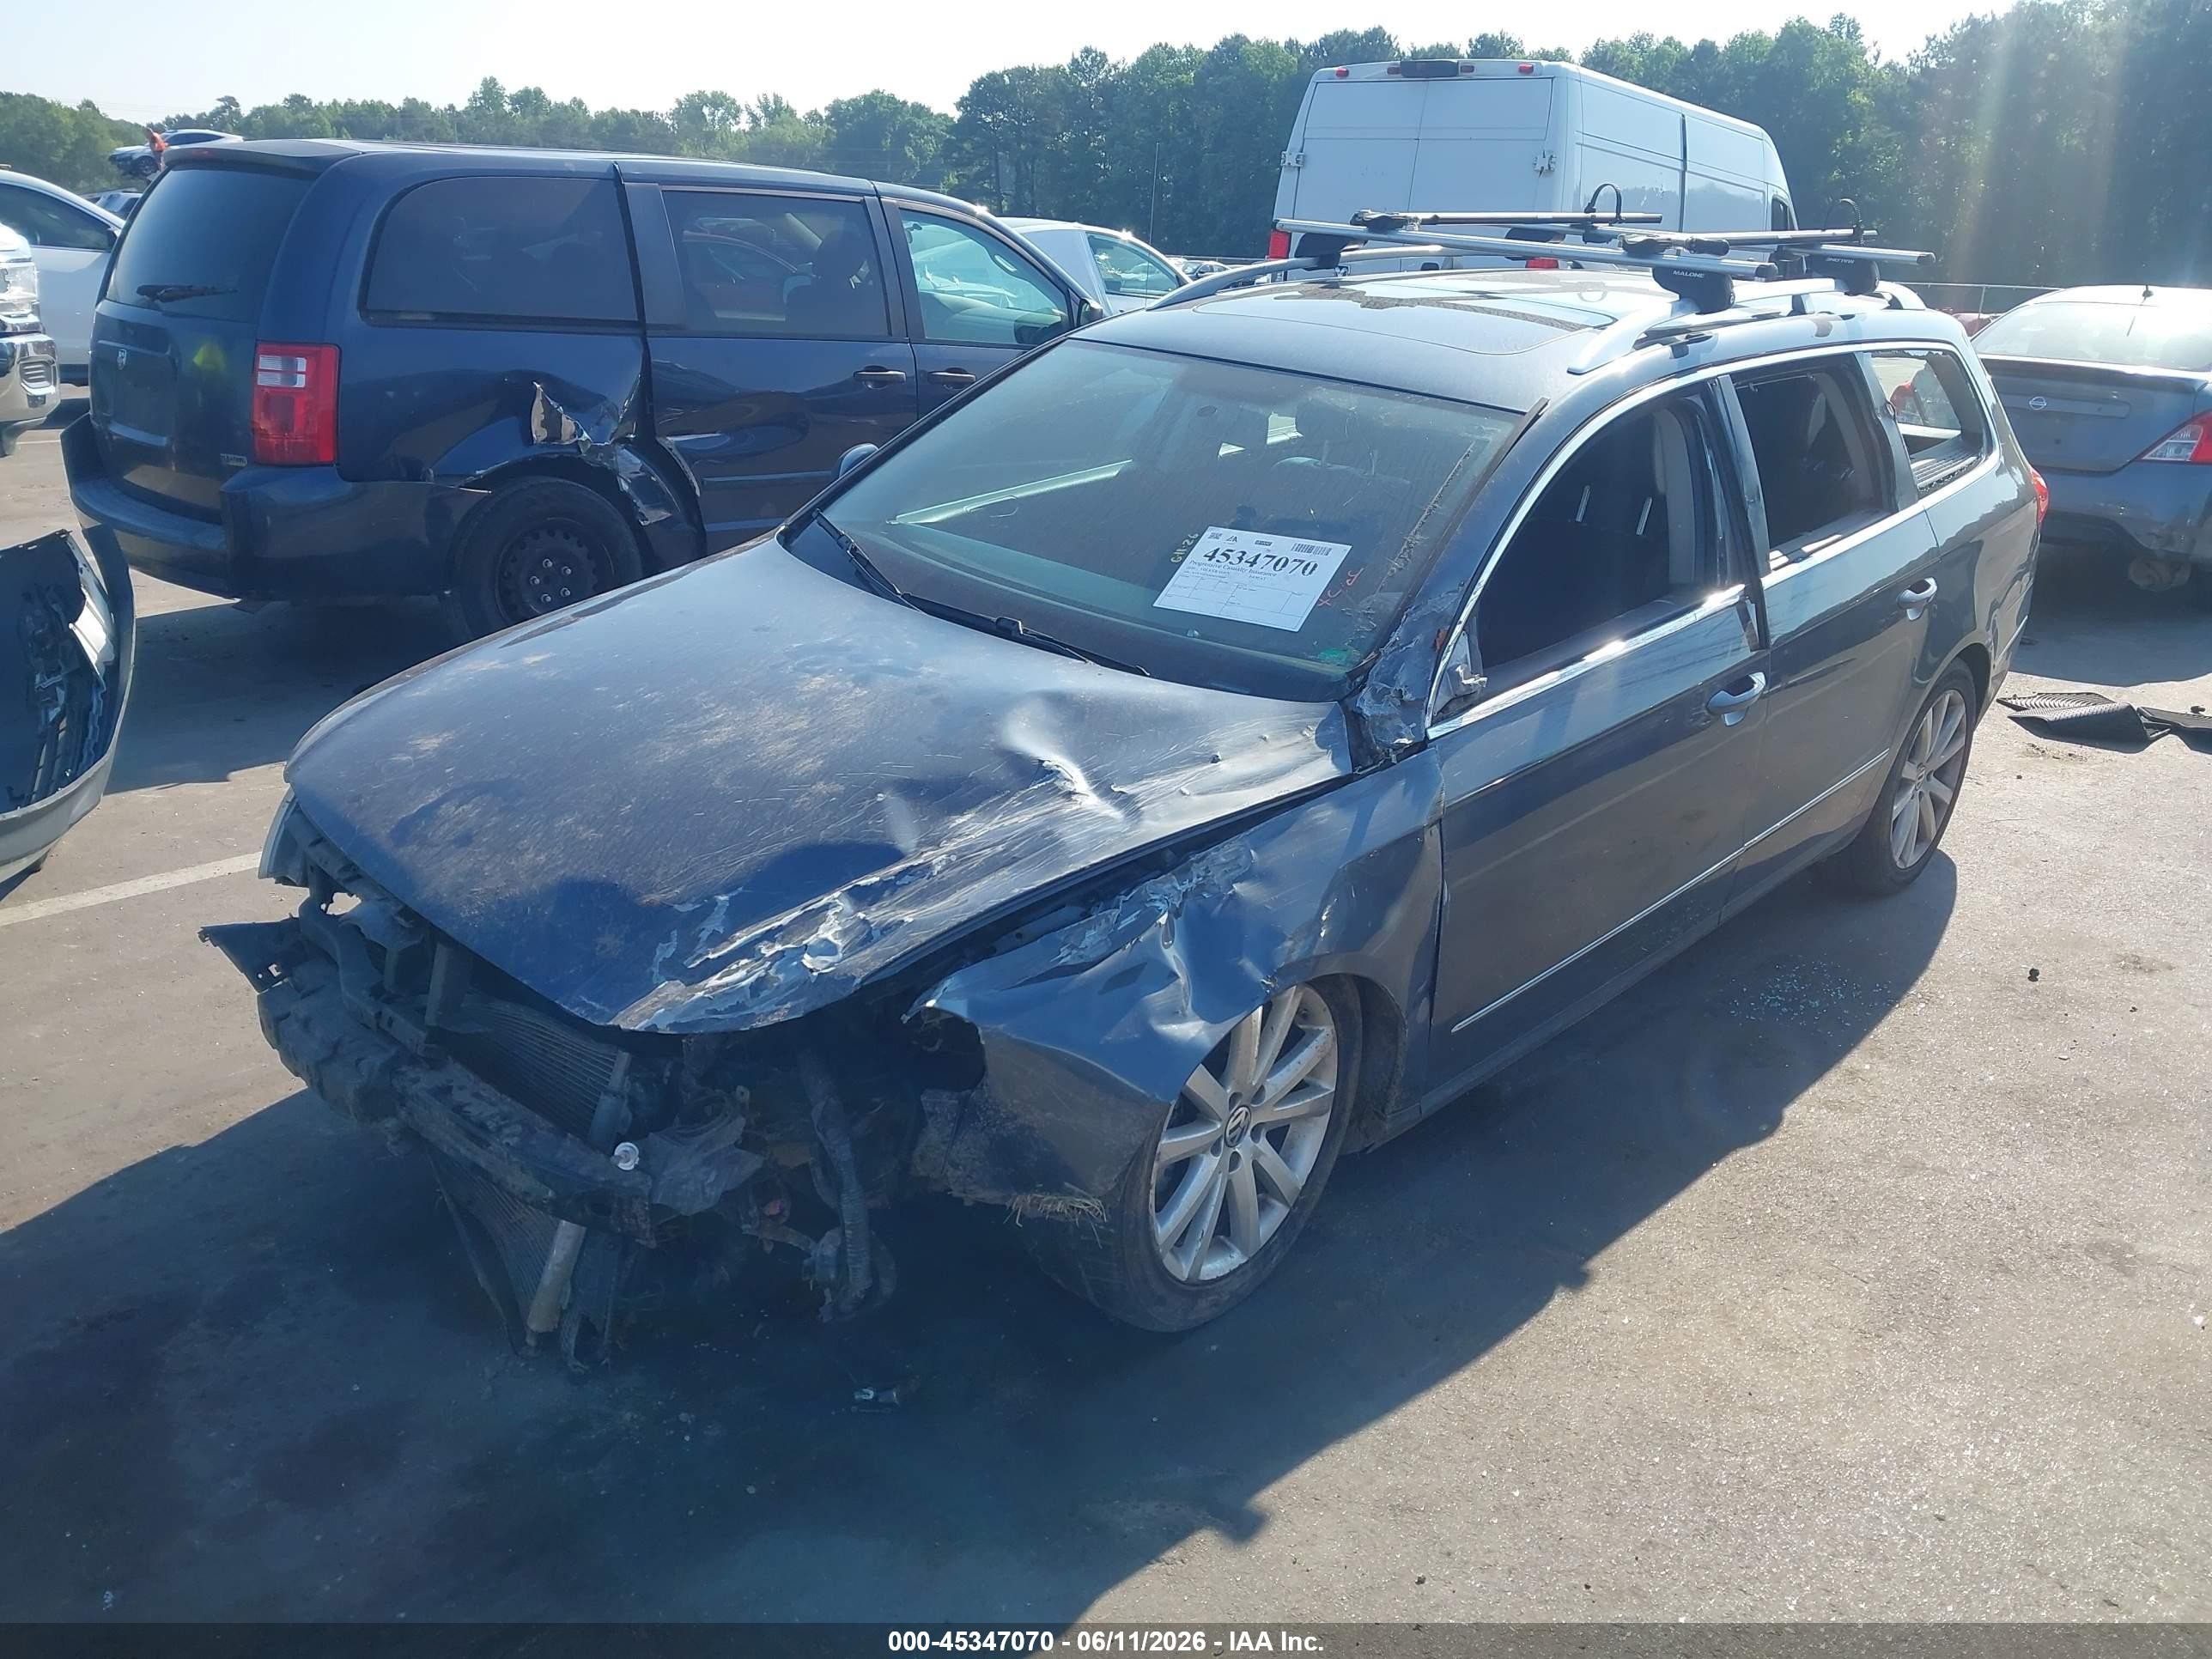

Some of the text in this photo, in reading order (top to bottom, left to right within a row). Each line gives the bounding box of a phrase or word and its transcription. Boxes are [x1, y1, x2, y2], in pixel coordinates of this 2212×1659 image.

[1673, 270, 1705, 278] MALONE
[1189, 560, 1220, 569] Progressive
[1223, 565, 1247, 574] Casualty
[1249, 568, 1278, 577] Insurance
[1203, 547, 1318, 577] 45347070
